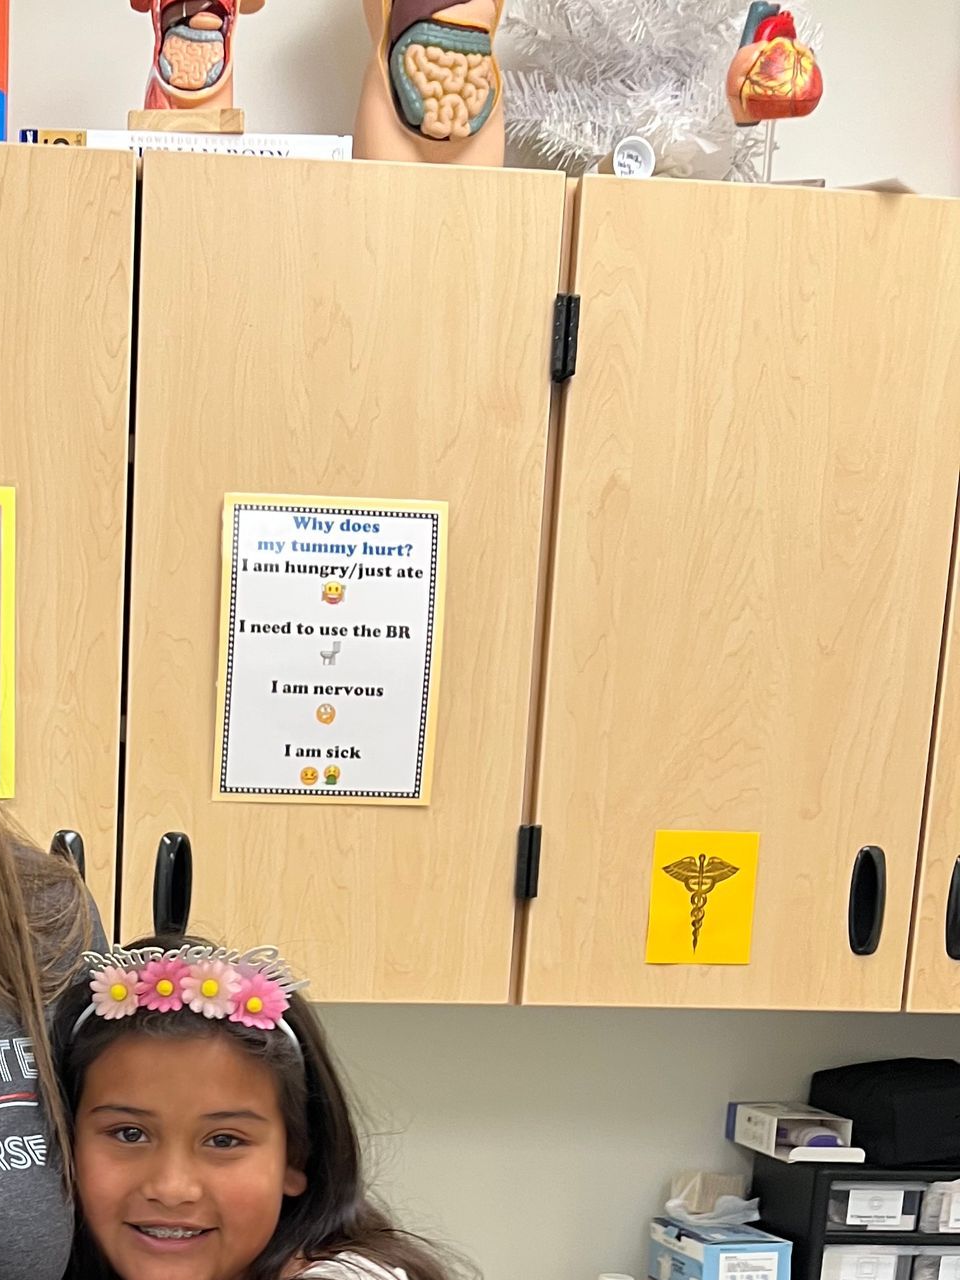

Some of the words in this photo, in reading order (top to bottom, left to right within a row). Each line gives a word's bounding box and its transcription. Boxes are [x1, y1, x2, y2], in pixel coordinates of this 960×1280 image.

[293, 515, 334, 534] Why
[339, 518, 381, 533] does
[257, 539, 286, 555] my
[291, 539, 358, 557] tummy
[362, 542, 414, 557] hurt?
[241, 558, 249, 572] I
[253, 562, 280, 573] am
[284, 560, 393, 580] hungry/just
[397, 567, 424, 579] ate
[239, 619, 246, 633] I
[250, 622, 292, 635] need
[296, 623, 315, 636] to
[319, 626, 348, 637] use
[352, 624, 382, 638] the
[386, 626, 411, 639] BR
[271, 680, 278, 694] I
[282, 684, 309, 695] am
[313, 684, 384, 697] nervous
[284, 744, 291, 757] I
[295, 747, 322, 758] am
[326, 746, 361, 760] sick
